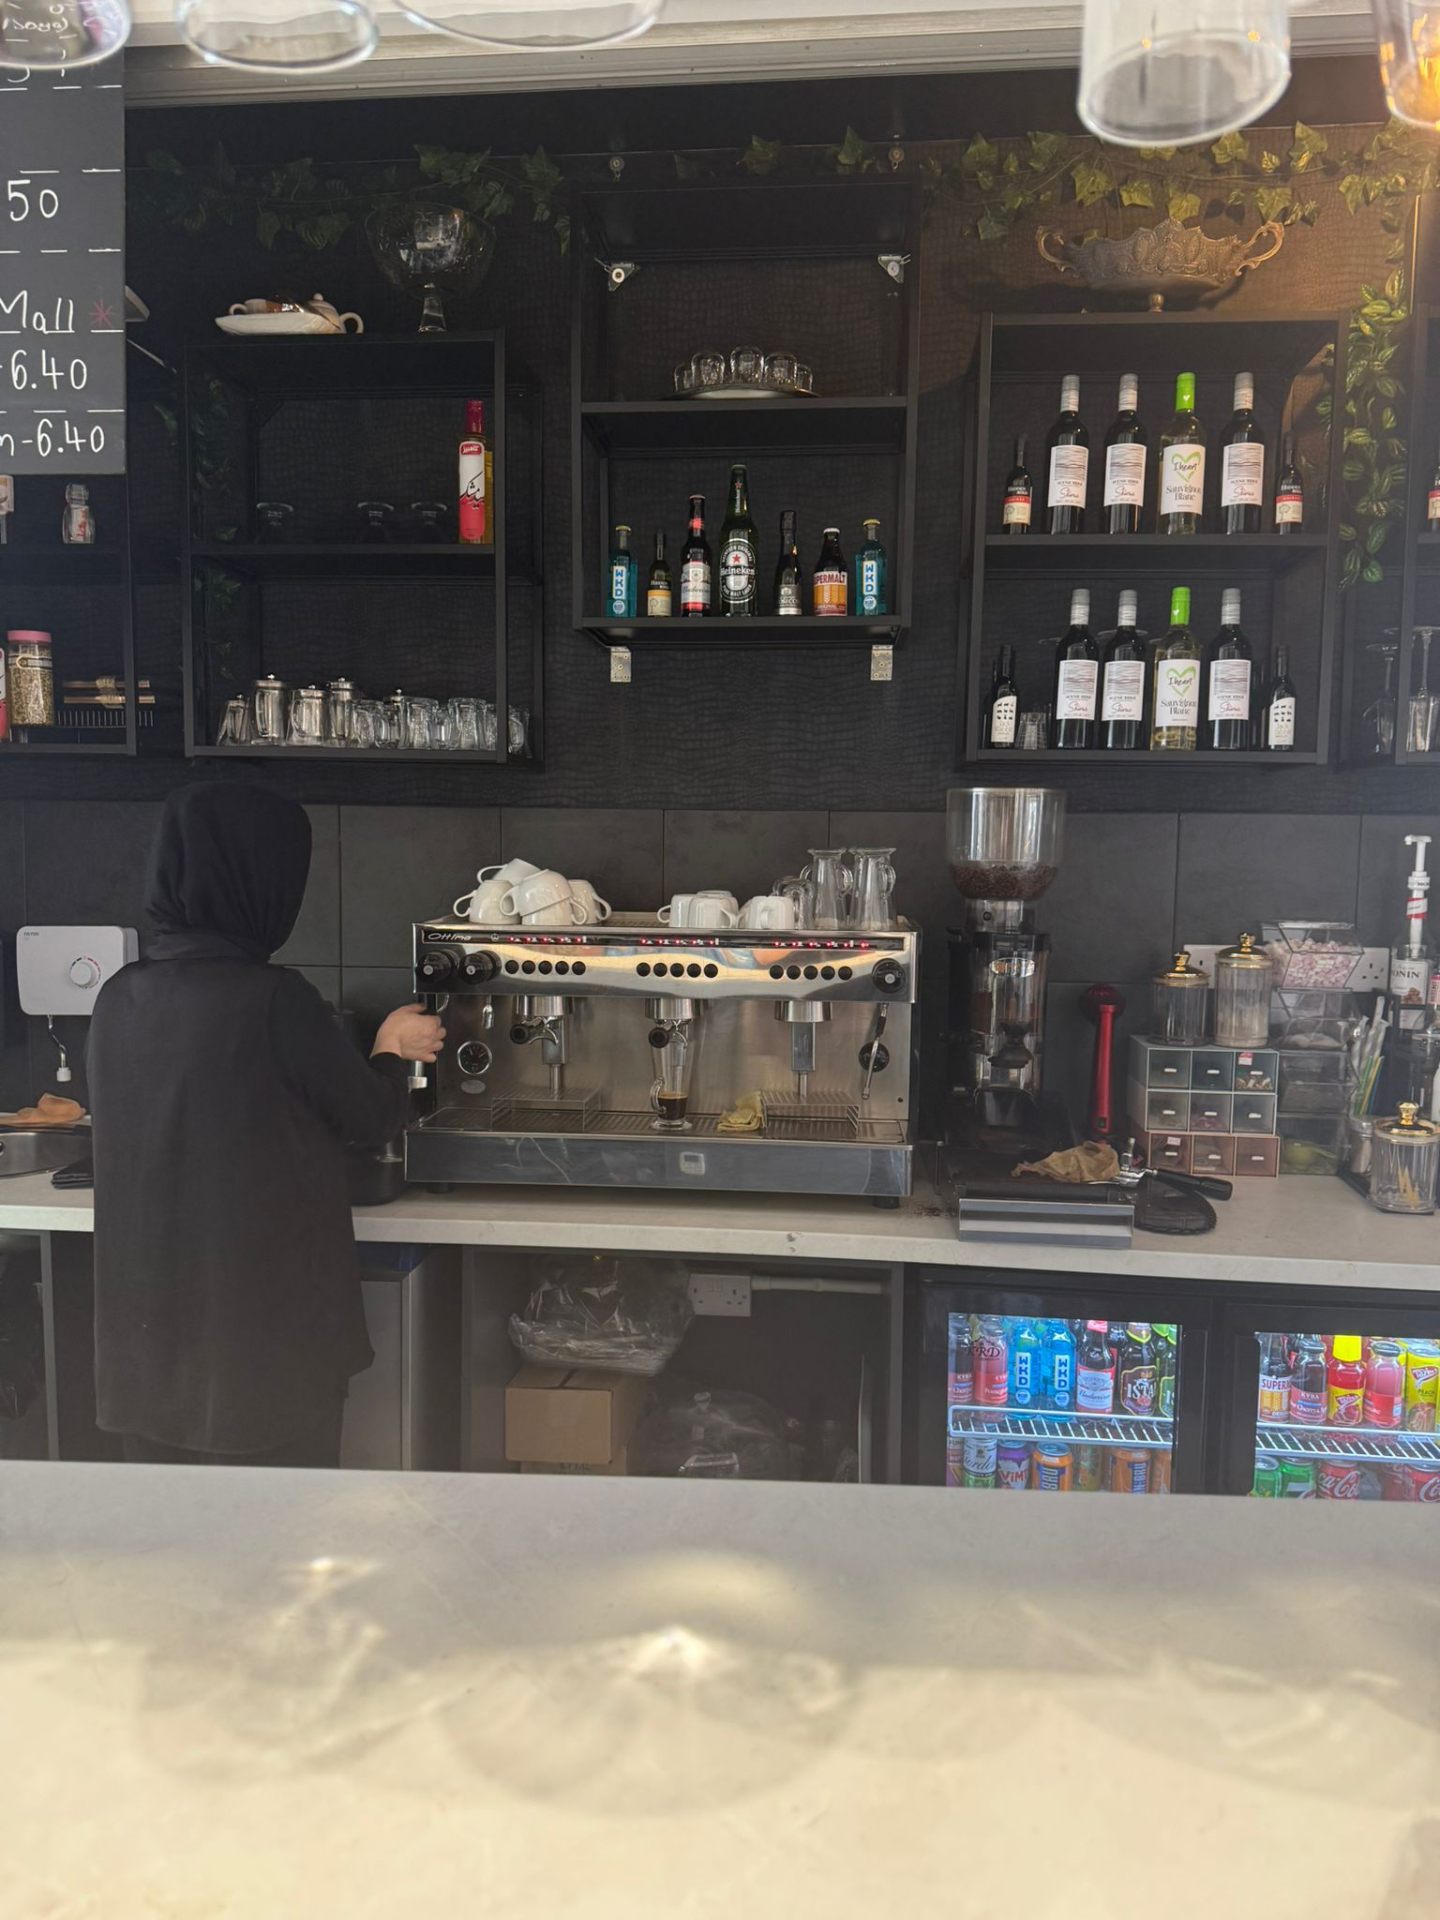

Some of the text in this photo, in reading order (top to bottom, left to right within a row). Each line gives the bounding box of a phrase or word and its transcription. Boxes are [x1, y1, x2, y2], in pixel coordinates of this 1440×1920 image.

[615, 568, 624, 597] WKD
[720, 565, 756, 576] Heineken
[865, 563, 875, 593] WKD
[1017, 1355, 1030, 1387] WKD
[1057, 1358, 1068, 1388] WKD
